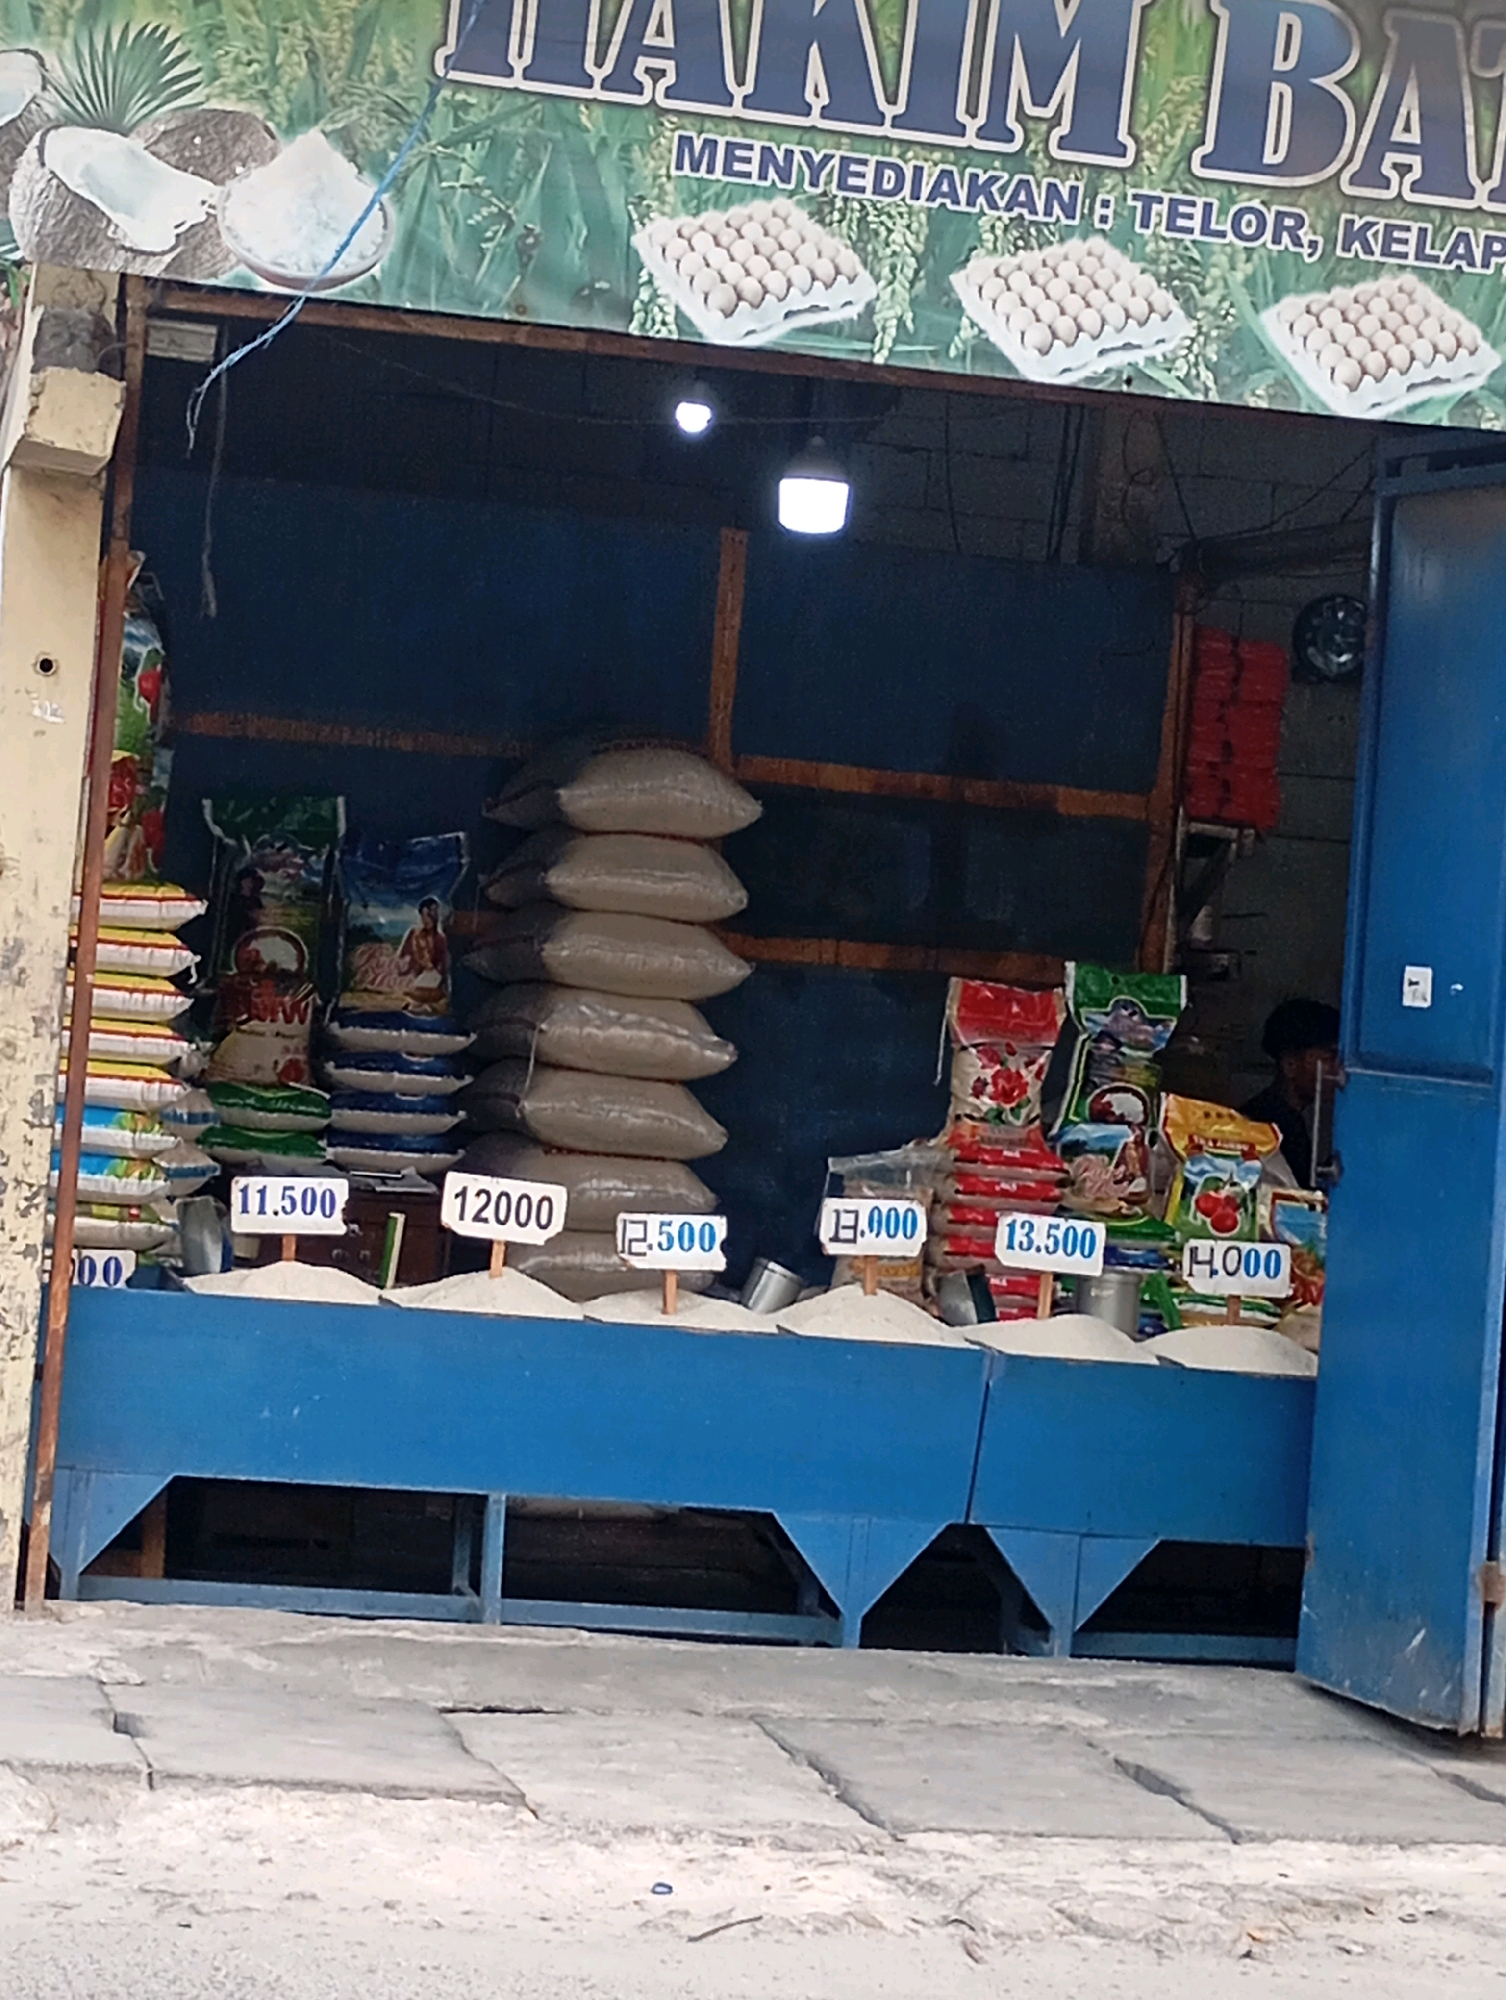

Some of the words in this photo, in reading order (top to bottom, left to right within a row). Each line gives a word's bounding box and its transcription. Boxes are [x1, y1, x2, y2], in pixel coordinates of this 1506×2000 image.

[674, 131, 1081, 226] MENYEDIAKAN
[1132, 192, 1322, 260] TELOR,
[1342, 218, 1506, 274] KELAP
[237, 1182, 338, 1219] 11.500
[453, 1185, 554, 1231] 12000
[1005, 1218, 1098, 1259] 13.500
